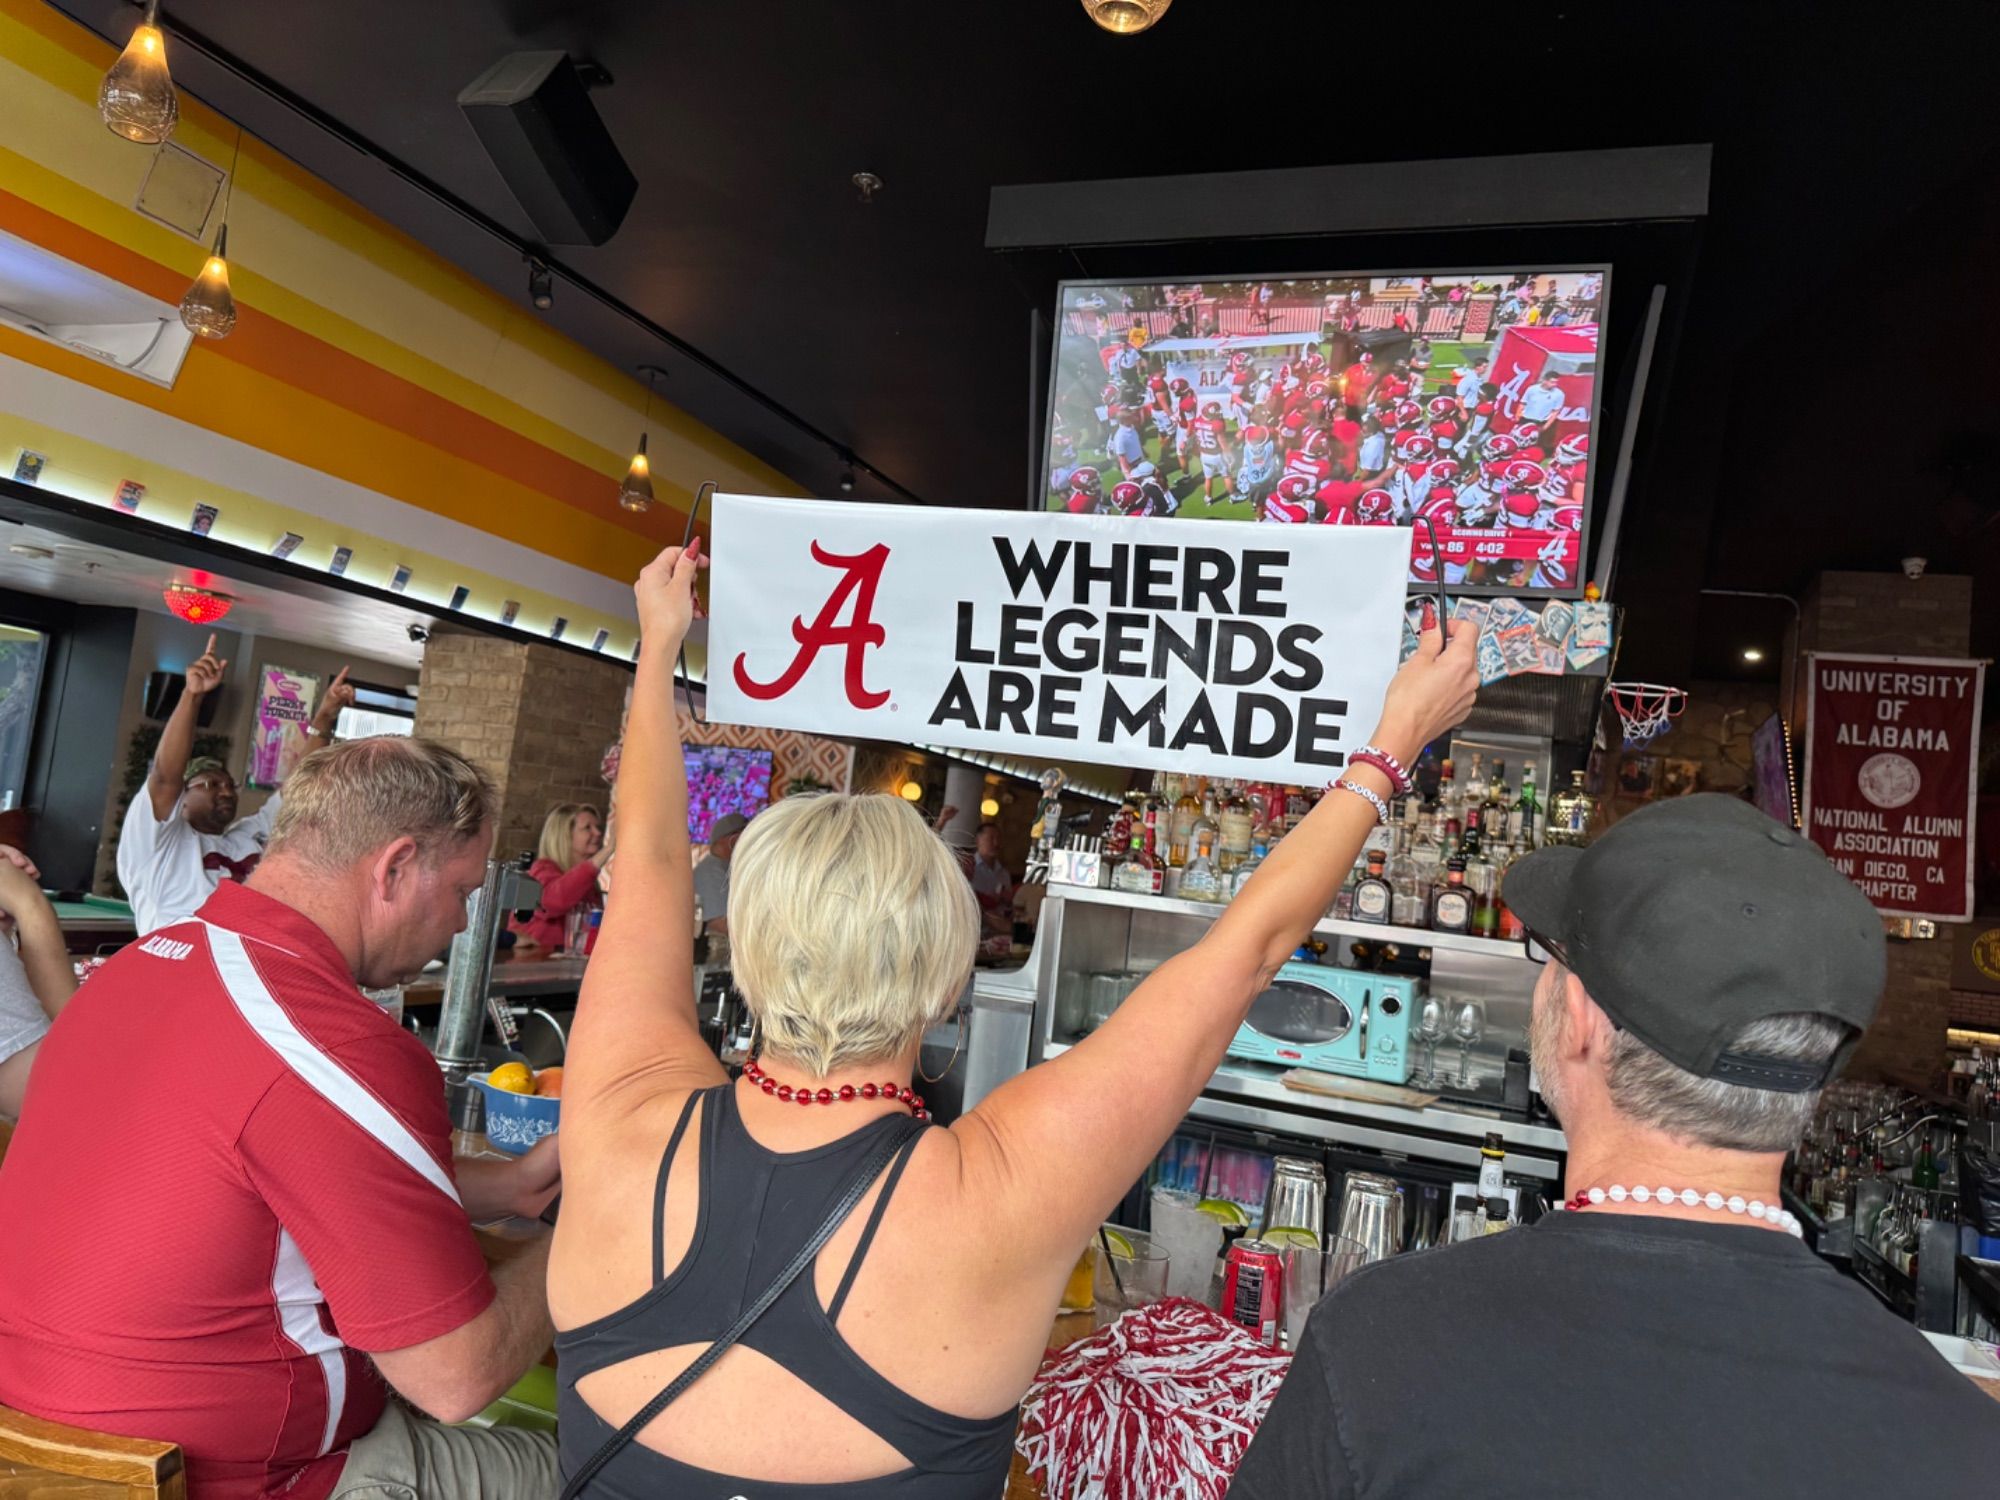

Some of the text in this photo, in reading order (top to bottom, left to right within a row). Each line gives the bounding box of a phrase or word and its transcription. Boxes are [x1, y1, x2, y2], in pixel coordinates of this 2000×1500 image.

[1475, 542, 1505, 554] 4:02
[992, 536, 1289, 618] WHERE
[734, 541, 891, 711] A
[954, 600, 1323, 692] LEGENDS
[1822, 669, 1968, 699] UNIVERSITY
[927, 666, 1348, 768] ARE MADE
[1877, 699, 1909, 721] OF
[1836, 723, 1949, 752] ALABAMA
[1814, 807, 1963, 838] NATIONAL ALUMNI
[1833, 831, 1940, 859] ASSOCIATION
[1864, 860, 1910, 882] DIEGO,
[1926, 866, 1945, 884] CA
